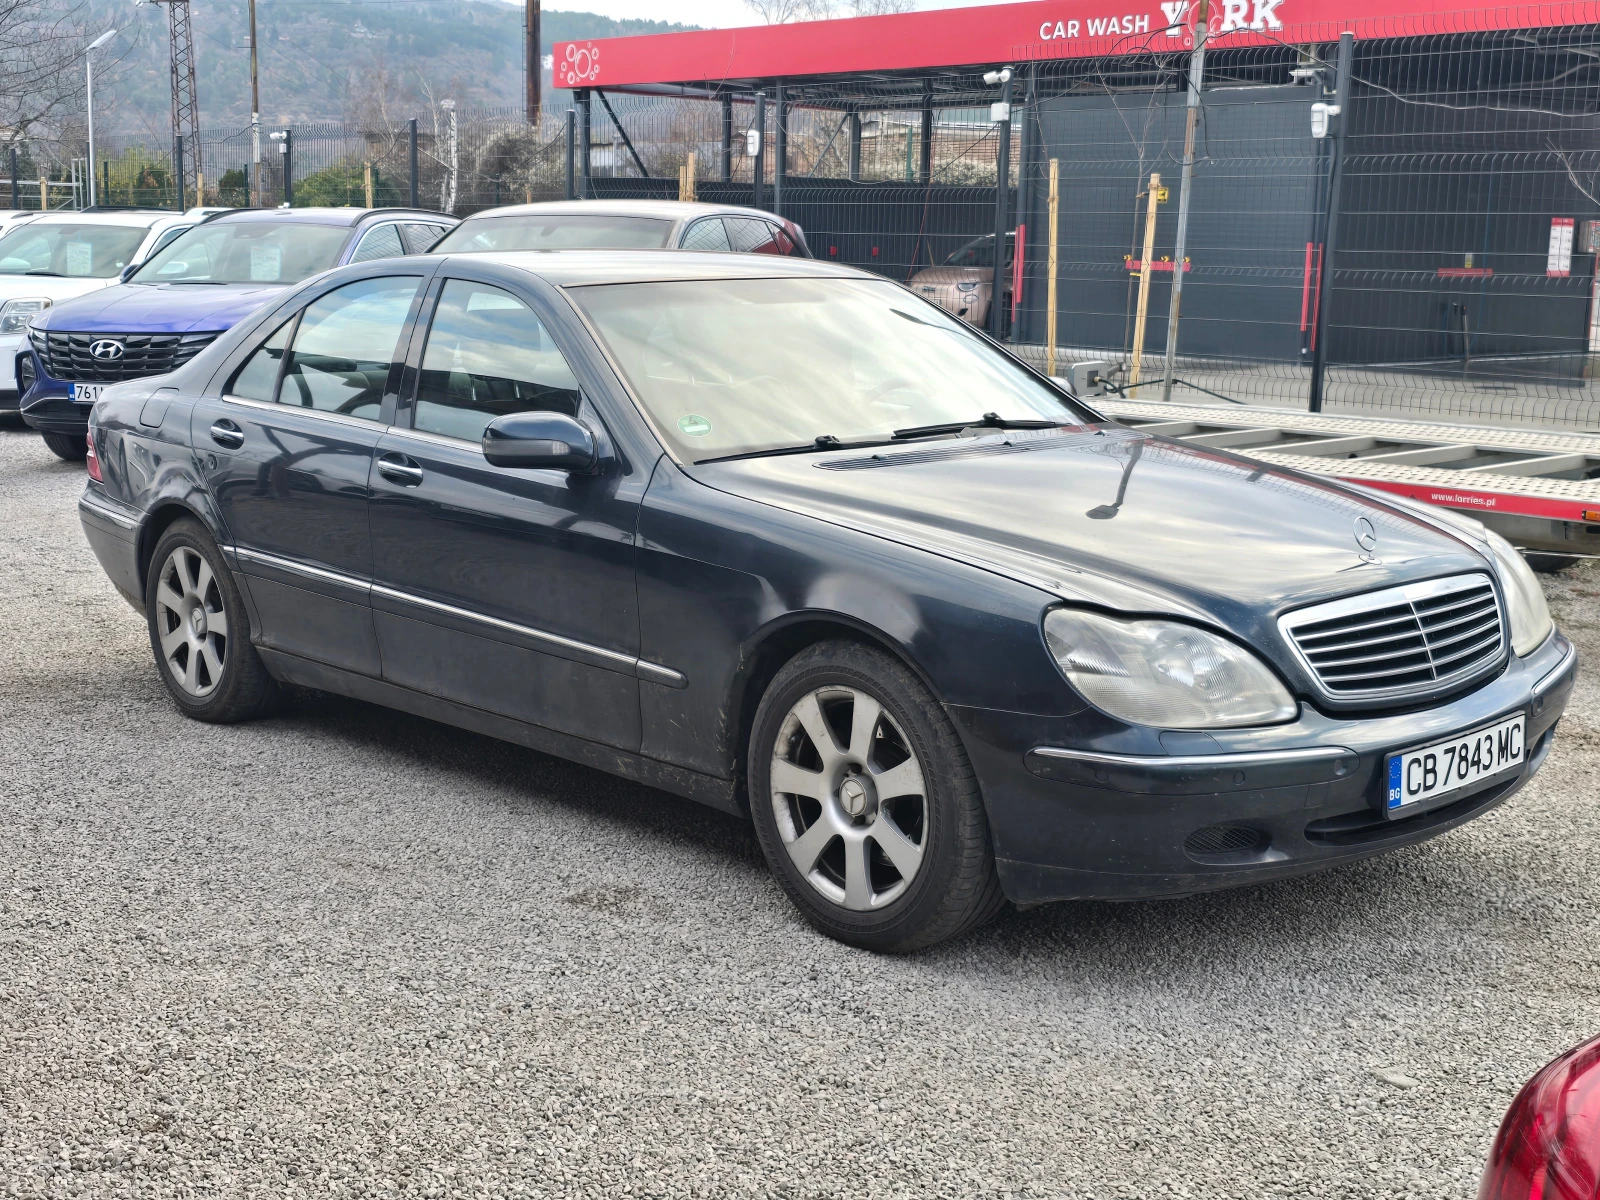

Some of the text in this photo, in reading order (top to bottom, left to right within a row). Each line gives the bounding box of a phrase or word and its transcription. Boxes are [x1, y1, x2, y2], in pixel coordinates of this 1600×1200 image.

[1039, 19, 1080, 40] CAR
[1086, 14, 1149, 36] WASH
[1431, 493, 1496, 507] www.lorries.pl
[1407, 723, 1521, 795] CB 7843 MC
[1389, 787, 1401, 801] BG
